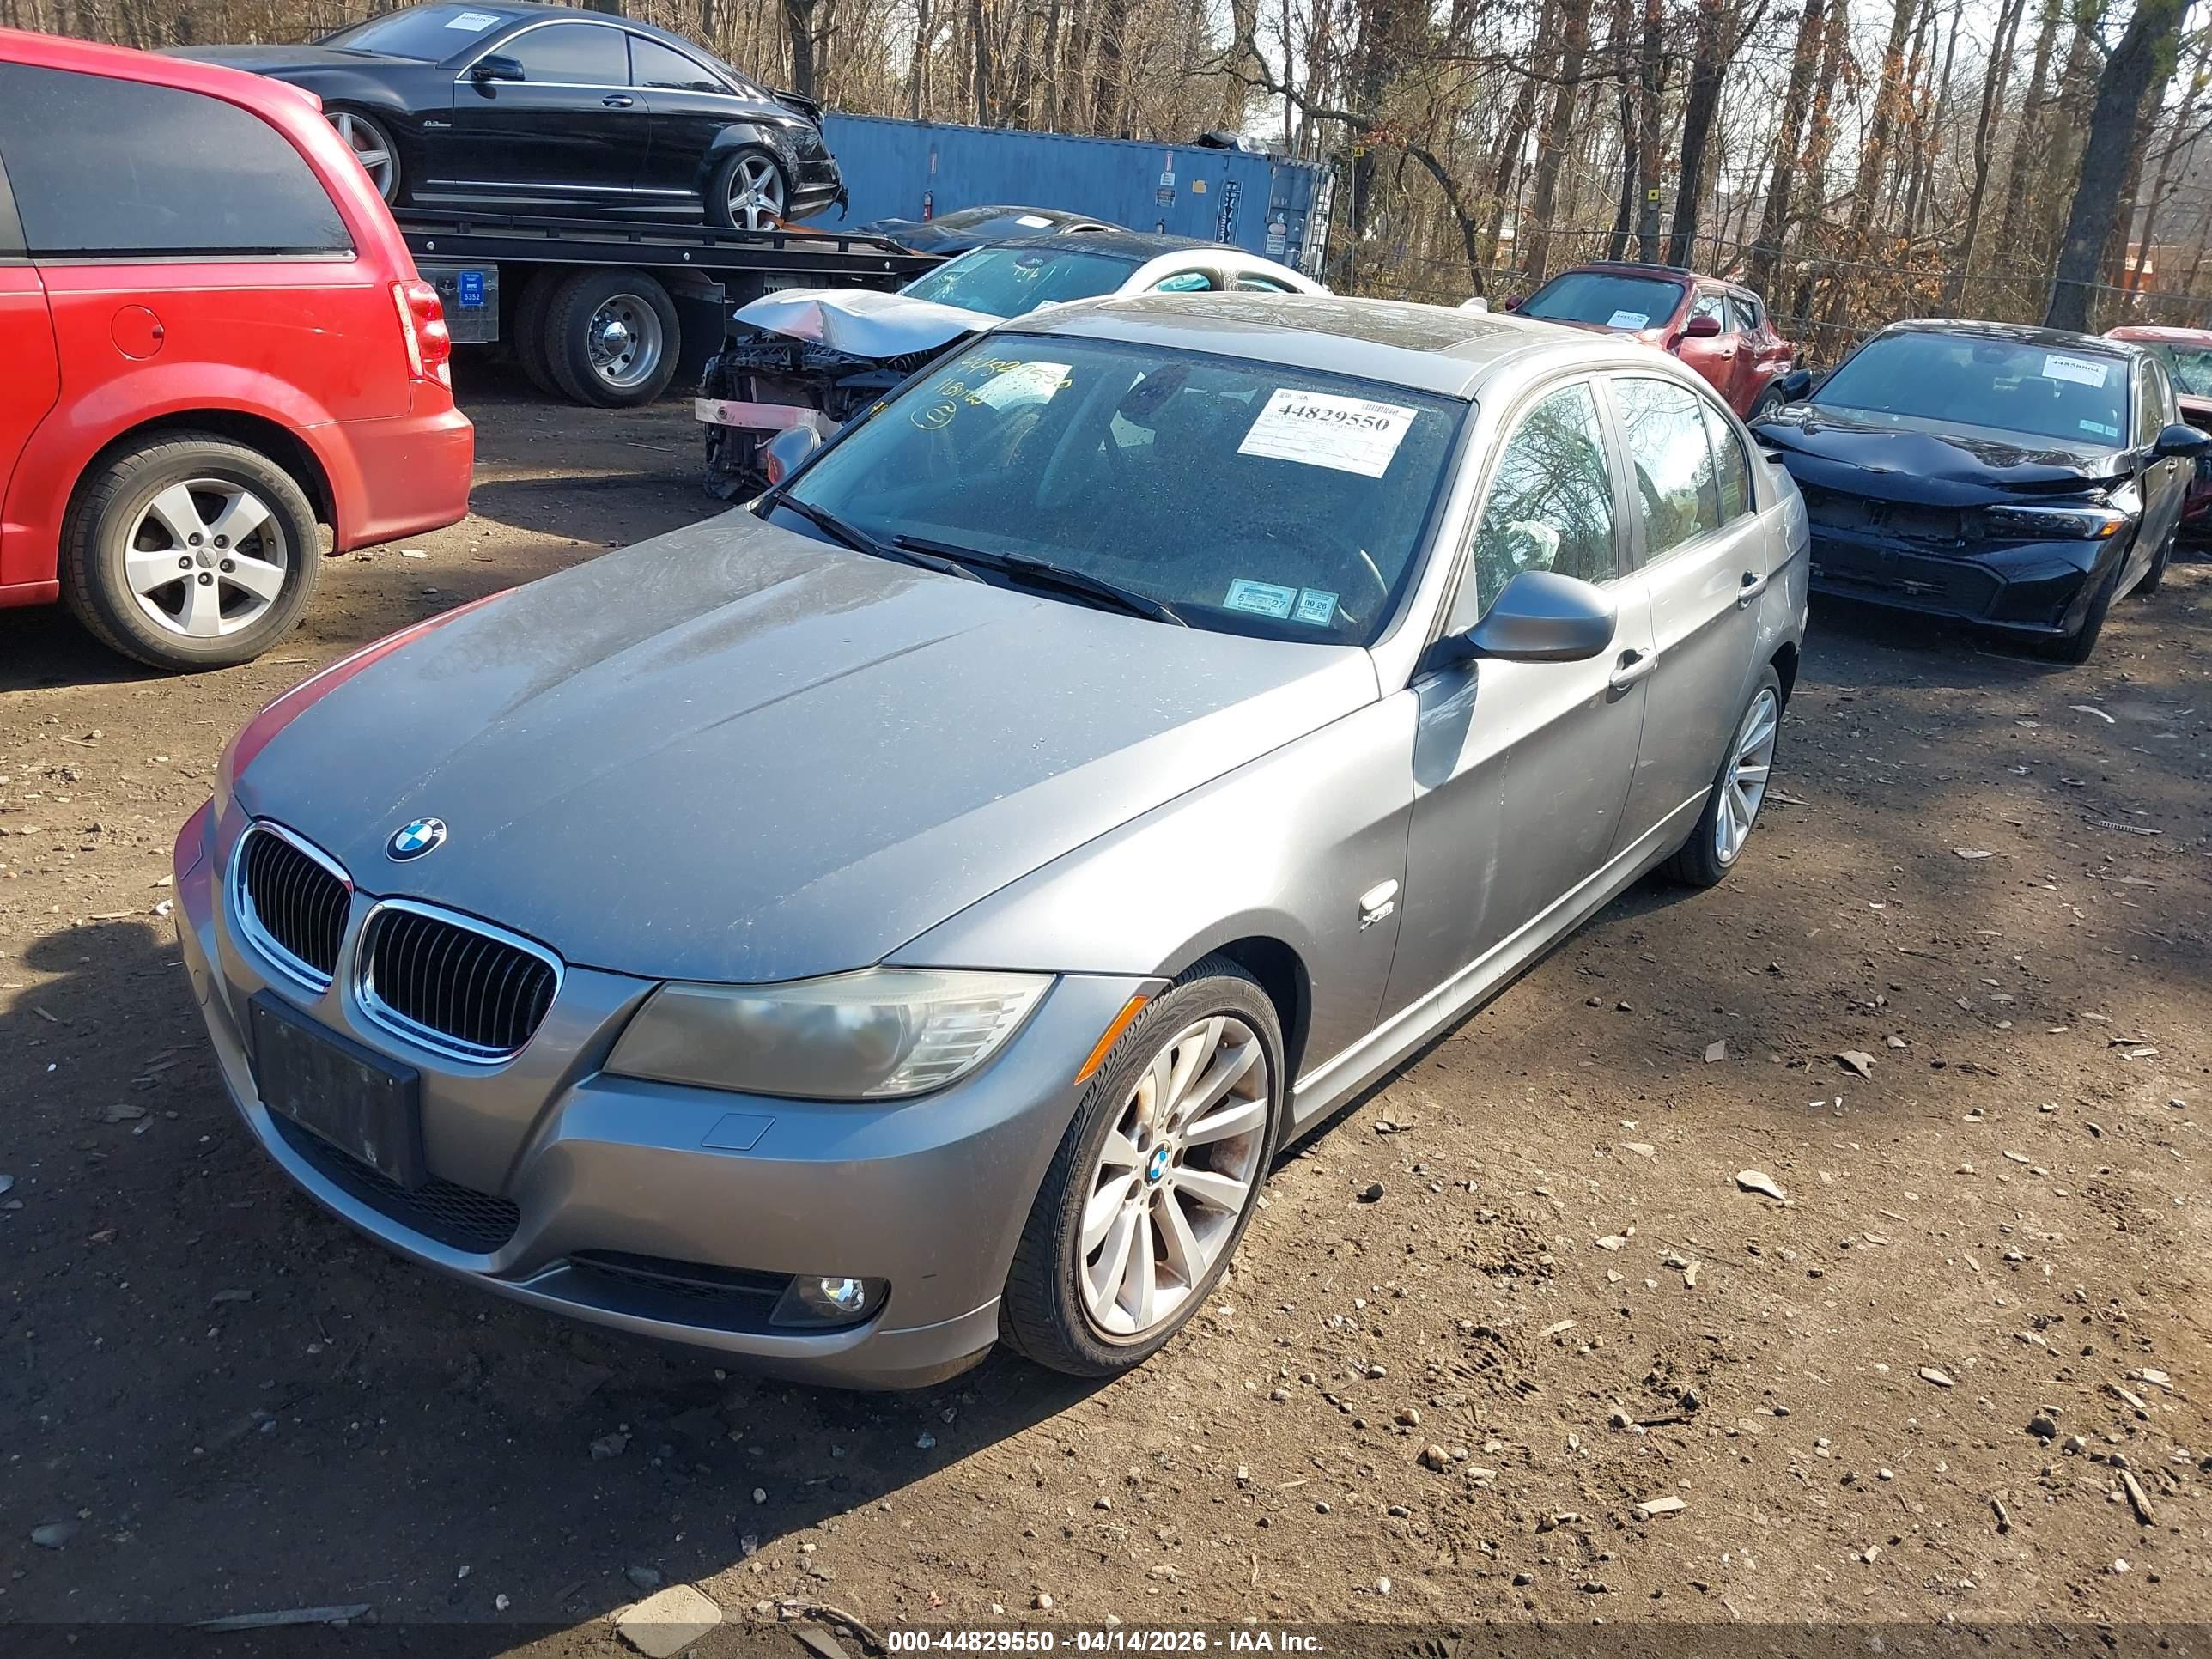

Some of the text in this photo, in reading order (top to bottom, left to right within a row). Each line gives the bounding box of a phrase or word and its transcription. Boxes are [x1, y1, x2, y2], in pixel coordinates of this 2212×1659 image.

[1278, 404, 1389, 432] 44829550
[1237, 593, 1245, 602] 5
[1271, 599, 1287, 609] 27
[1304, 599, 1315, 608] 09
